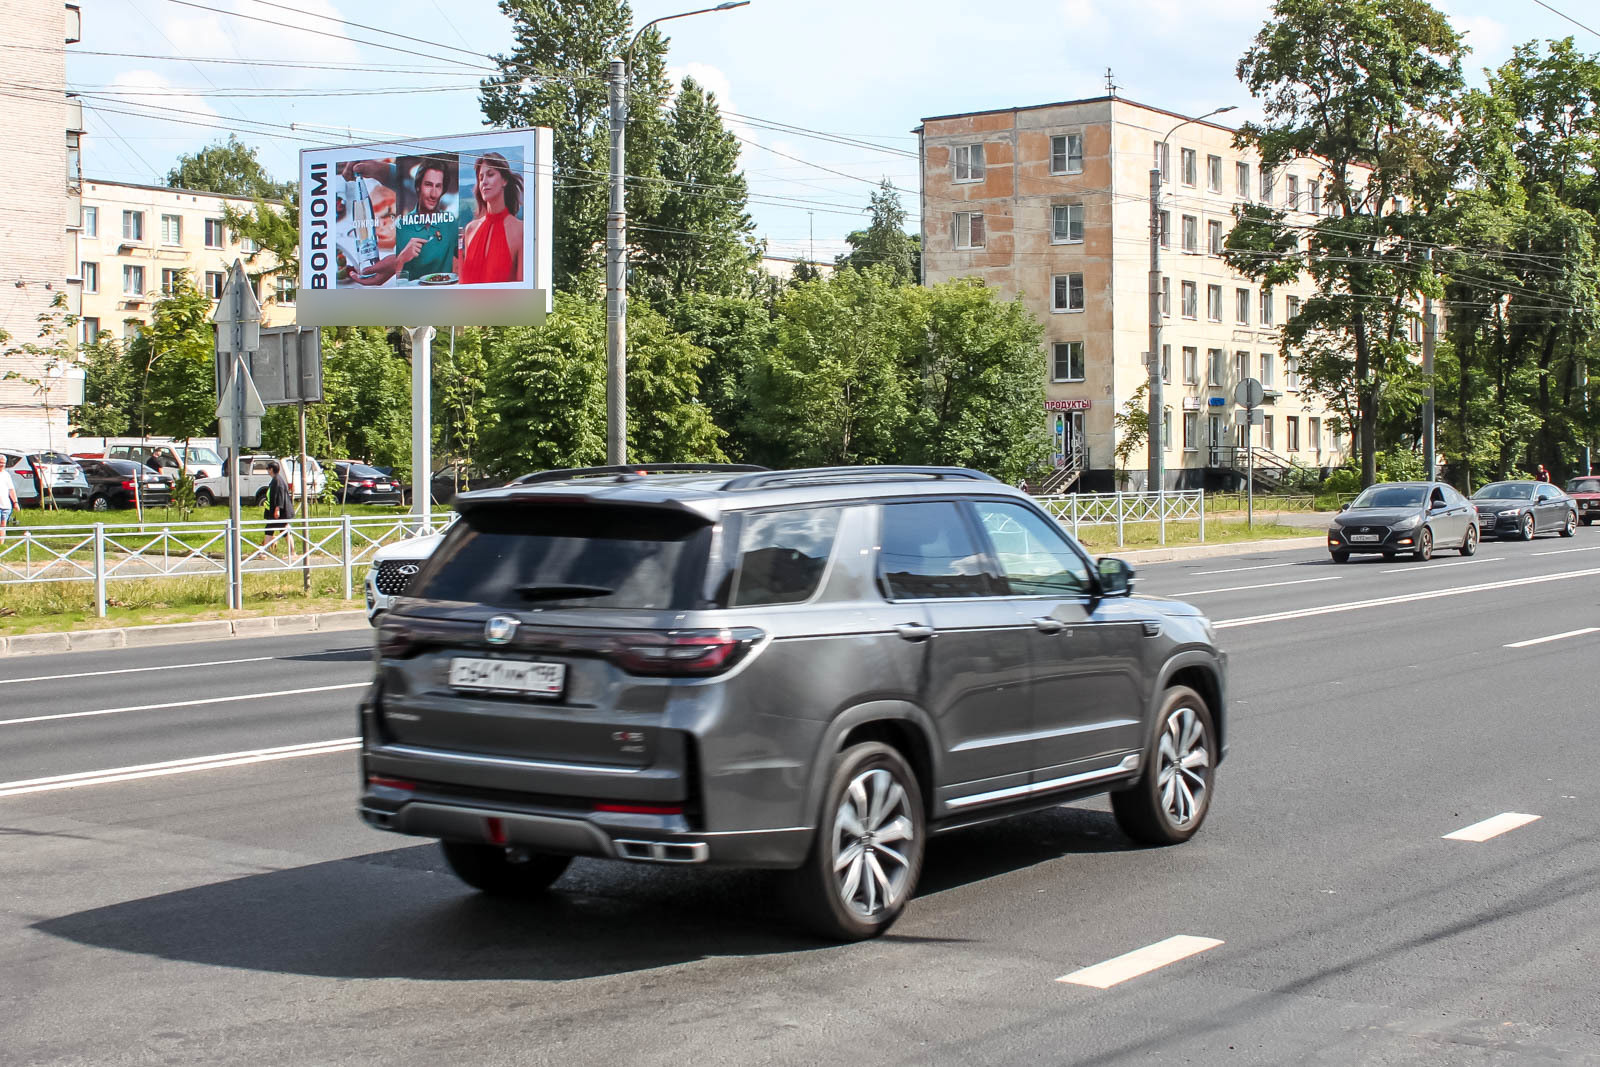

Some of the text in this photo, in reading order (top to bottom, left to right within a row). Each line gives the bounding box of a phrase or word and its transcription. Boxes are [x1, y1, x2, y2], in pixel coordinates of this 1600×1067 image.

[402, 212, 454, 226] НАСЛАДИСЬ
[311, 163, 328, 290] BORJOMI
[1044, 399, 1090, 410] ПРОДУКТЫ
